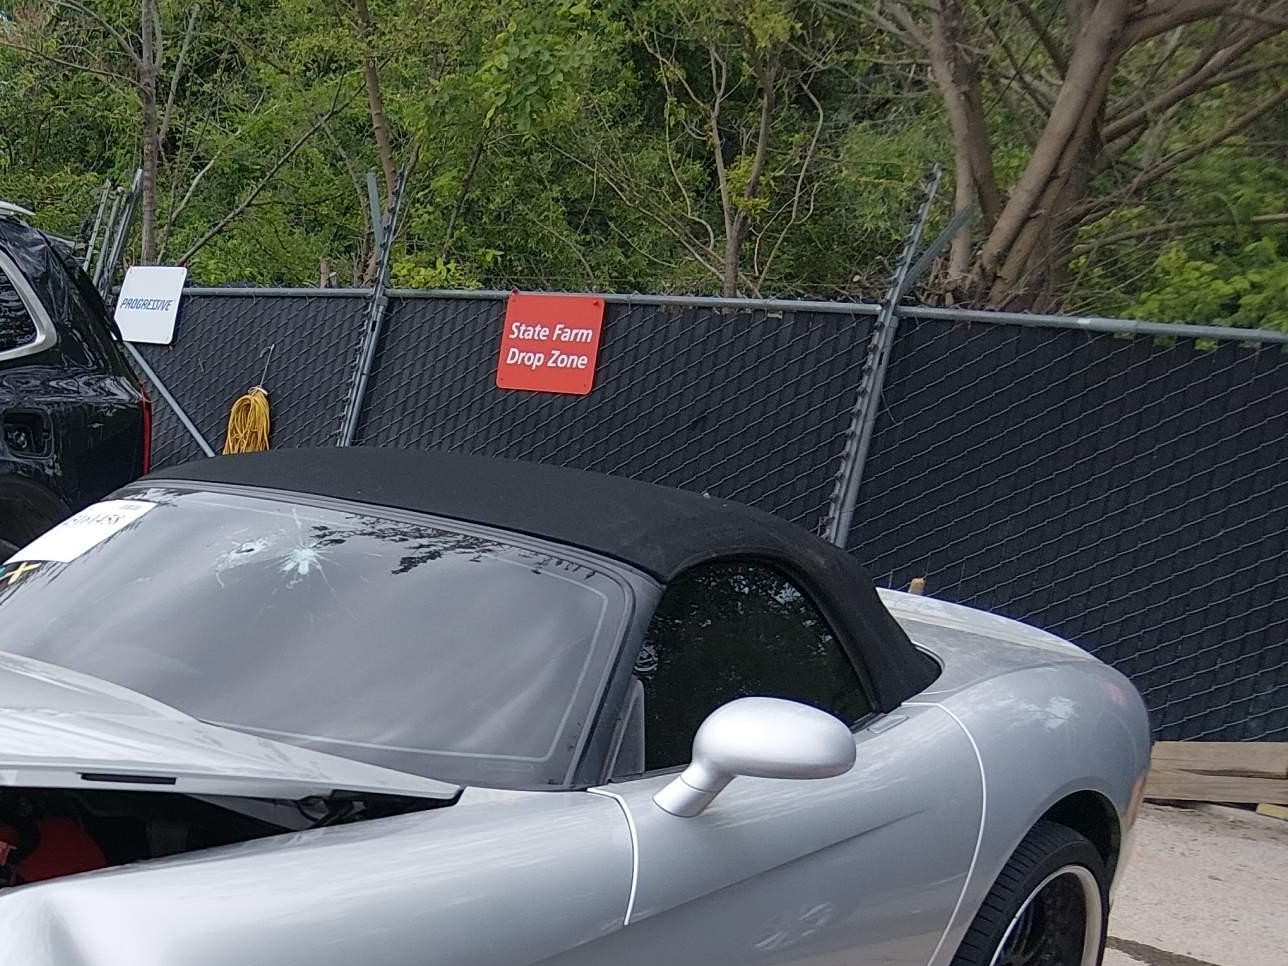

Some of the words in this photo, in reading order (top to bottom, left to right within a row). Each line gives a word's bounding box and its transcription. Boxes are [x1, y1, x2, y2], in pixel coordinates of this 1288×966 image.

[119, 297, 173, 311] PROGRESSIVE
[509, 322, 549, 340] State
[552, 324, 593, 342] Farm
[506, 348, 544, 370] Drop
[547, 351, 588, 369] Zone
